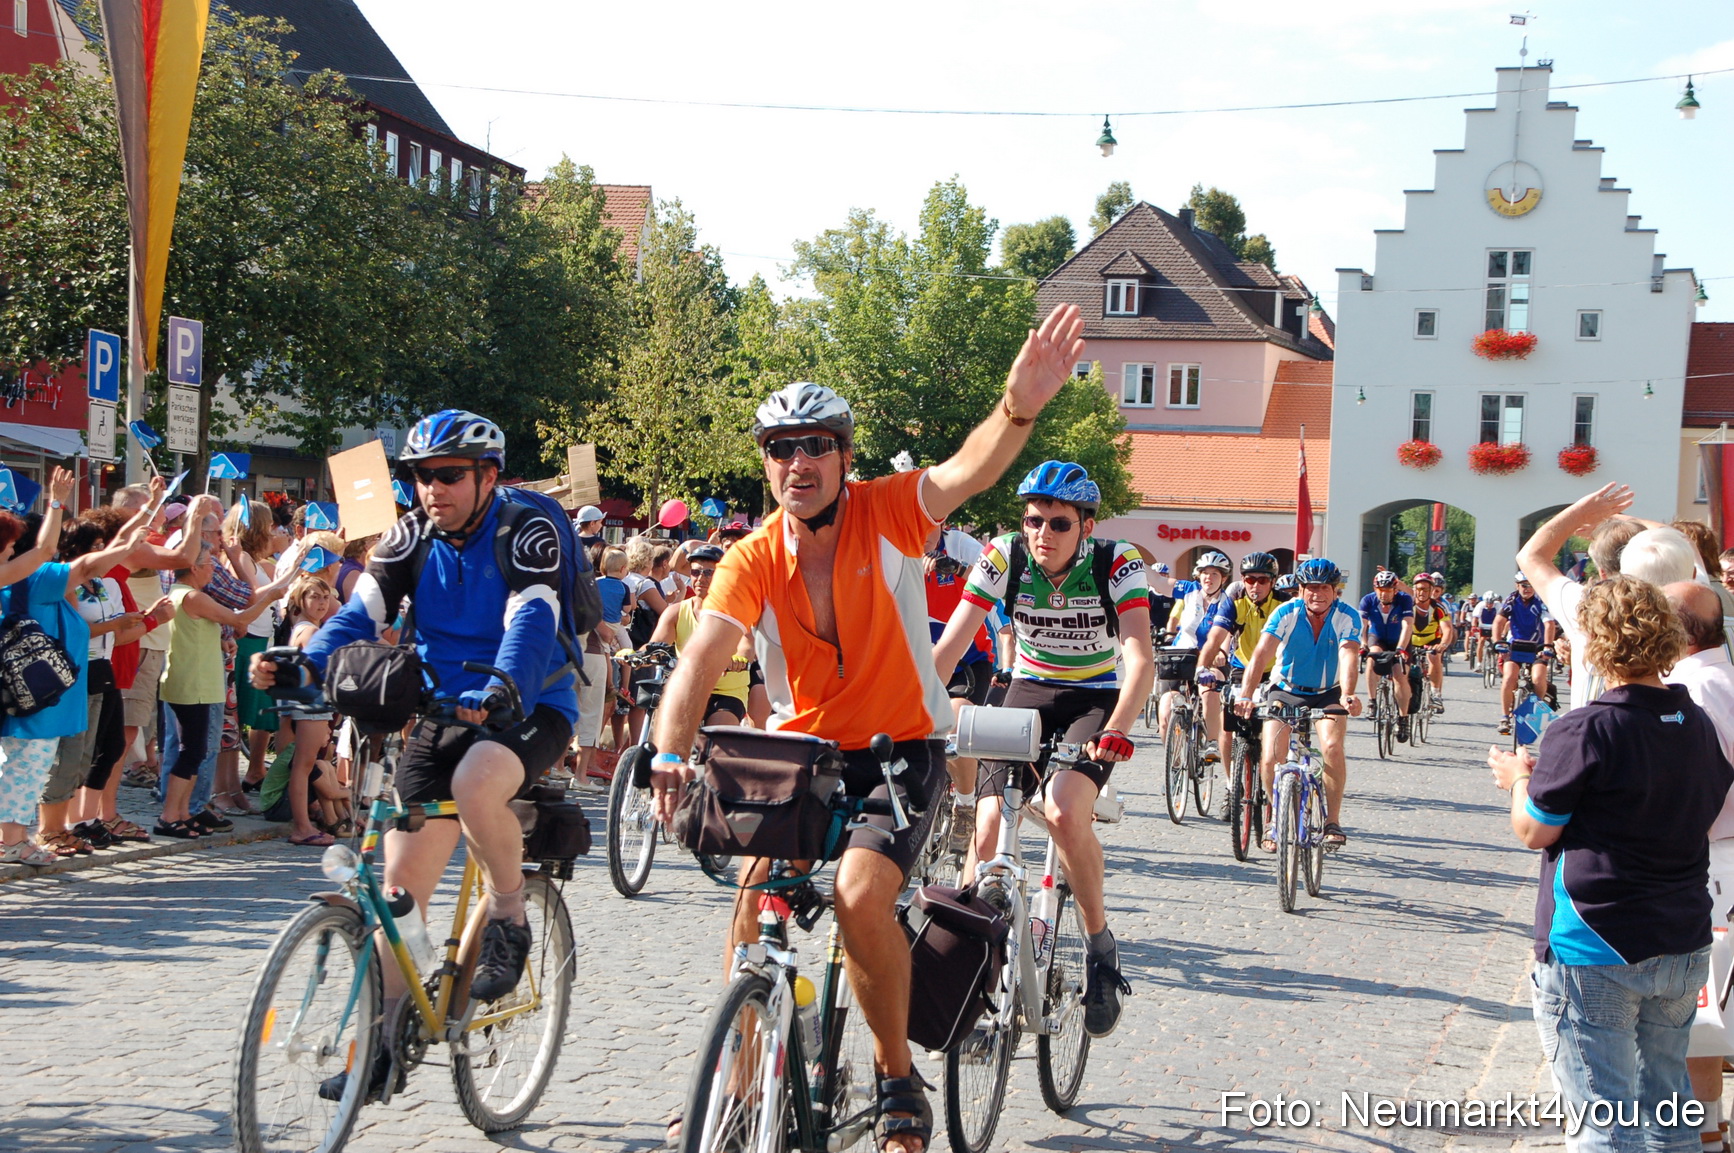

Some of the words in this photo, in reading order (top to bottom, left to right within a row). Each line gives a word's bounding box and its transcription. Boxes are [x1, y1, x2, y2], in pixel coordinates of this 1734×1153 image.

[176, 326, 195, 375] P
[95, 341, 113, 390] P
[1157, 524, 1252, 542] Sparkasse
[977, 556, 1000, 582] OOK
[1112, 560, 1144, 584] LOOK
